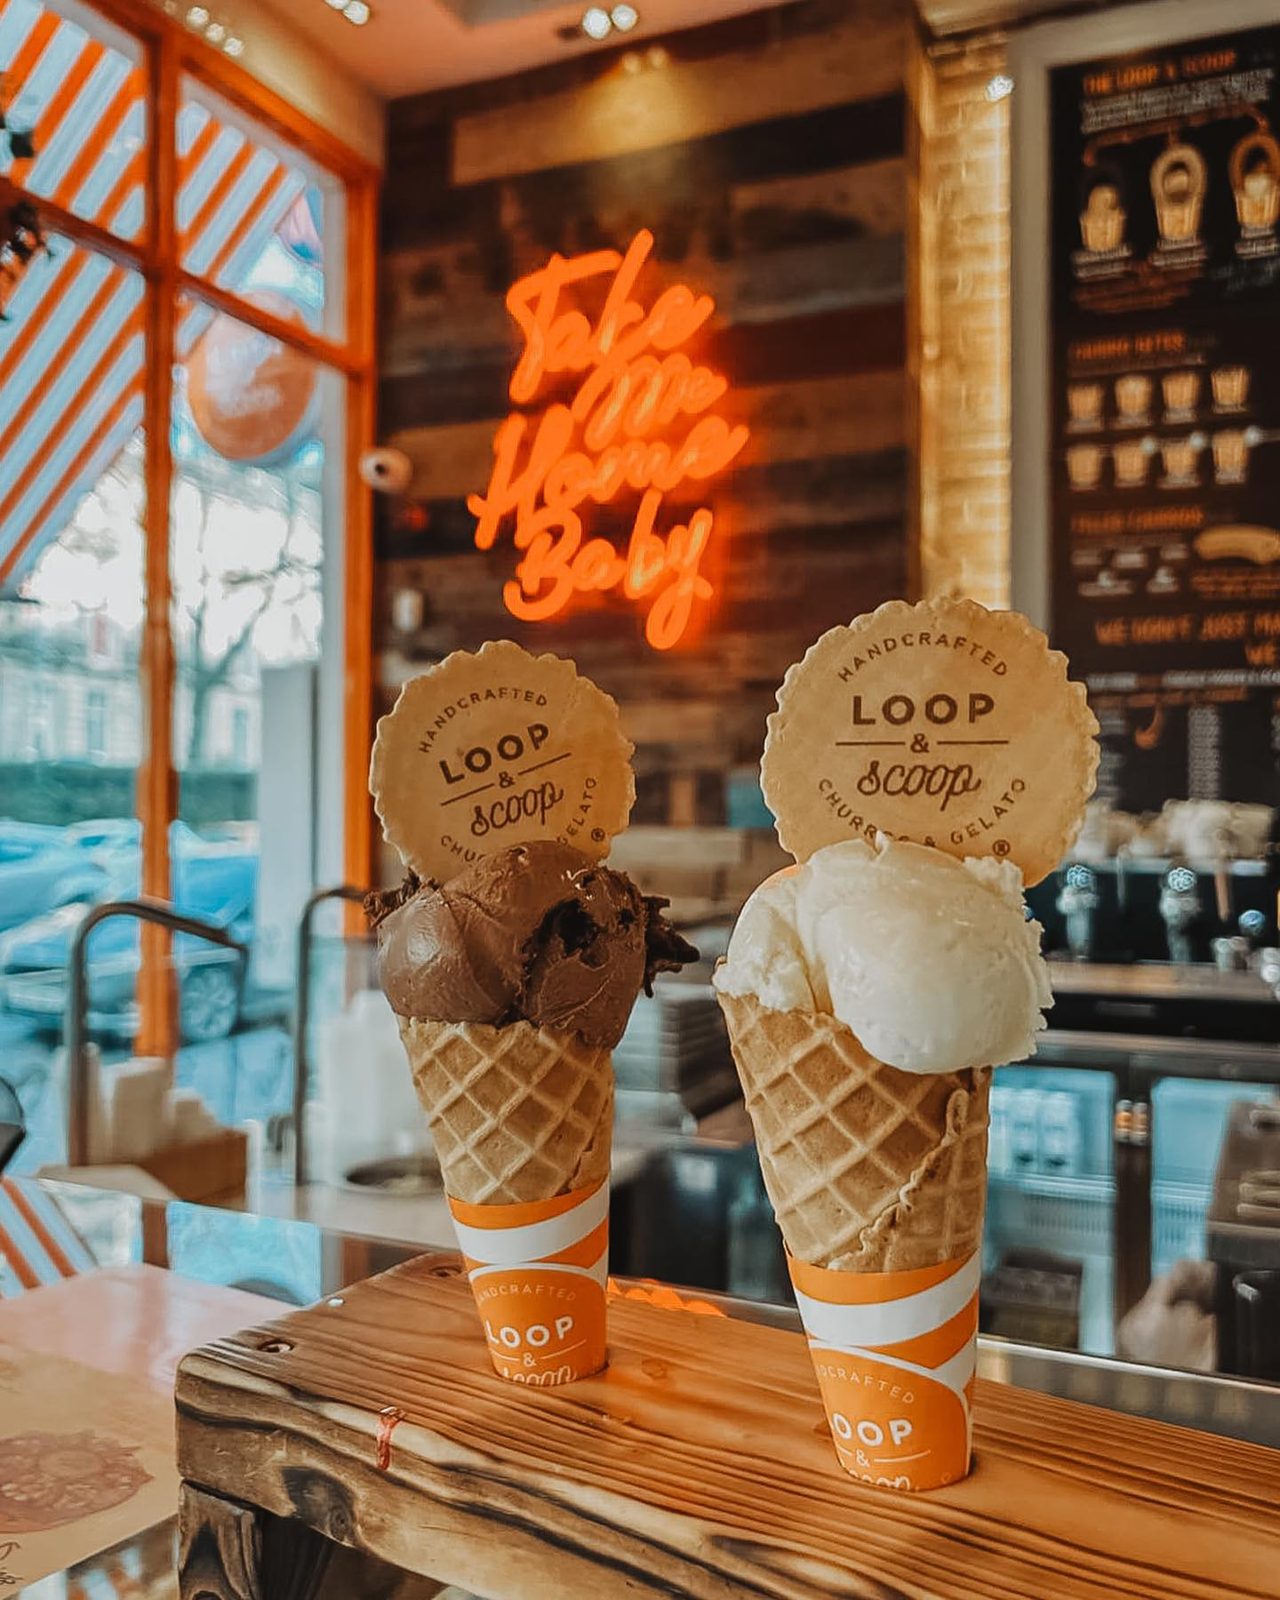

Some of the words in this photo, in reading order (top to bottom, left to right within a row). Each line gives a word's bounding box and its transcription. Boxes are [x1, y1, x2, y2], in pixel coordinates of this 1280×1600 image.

[506, 228, 715, 403] Take
[467, 403, 750, 550] Home
[503, 488, 714, 650] Baby
[838, 632, 1007, 682] HANDCRAFTED
[418, 687, 548, 753] HANDCRAFTED
[852, 693, 995, 725] LOOP
[439, 723, 549, 784] LOOP
[910, 733, 929, 753] &
[498, 771, 515, 788] &
[857, 760, 981, 811] scoop
[470, 781, 564, 836] scoop
[818, 779, 910, 843] CHURR
[951, 779, 1025, 845] GELATO
[485, 1316, 574, 1348] LOOP
[523, 1352, 537, 1367] &
[832, 1413, 913, 1446] OOP
[856, 1449, 870, 1467] &
